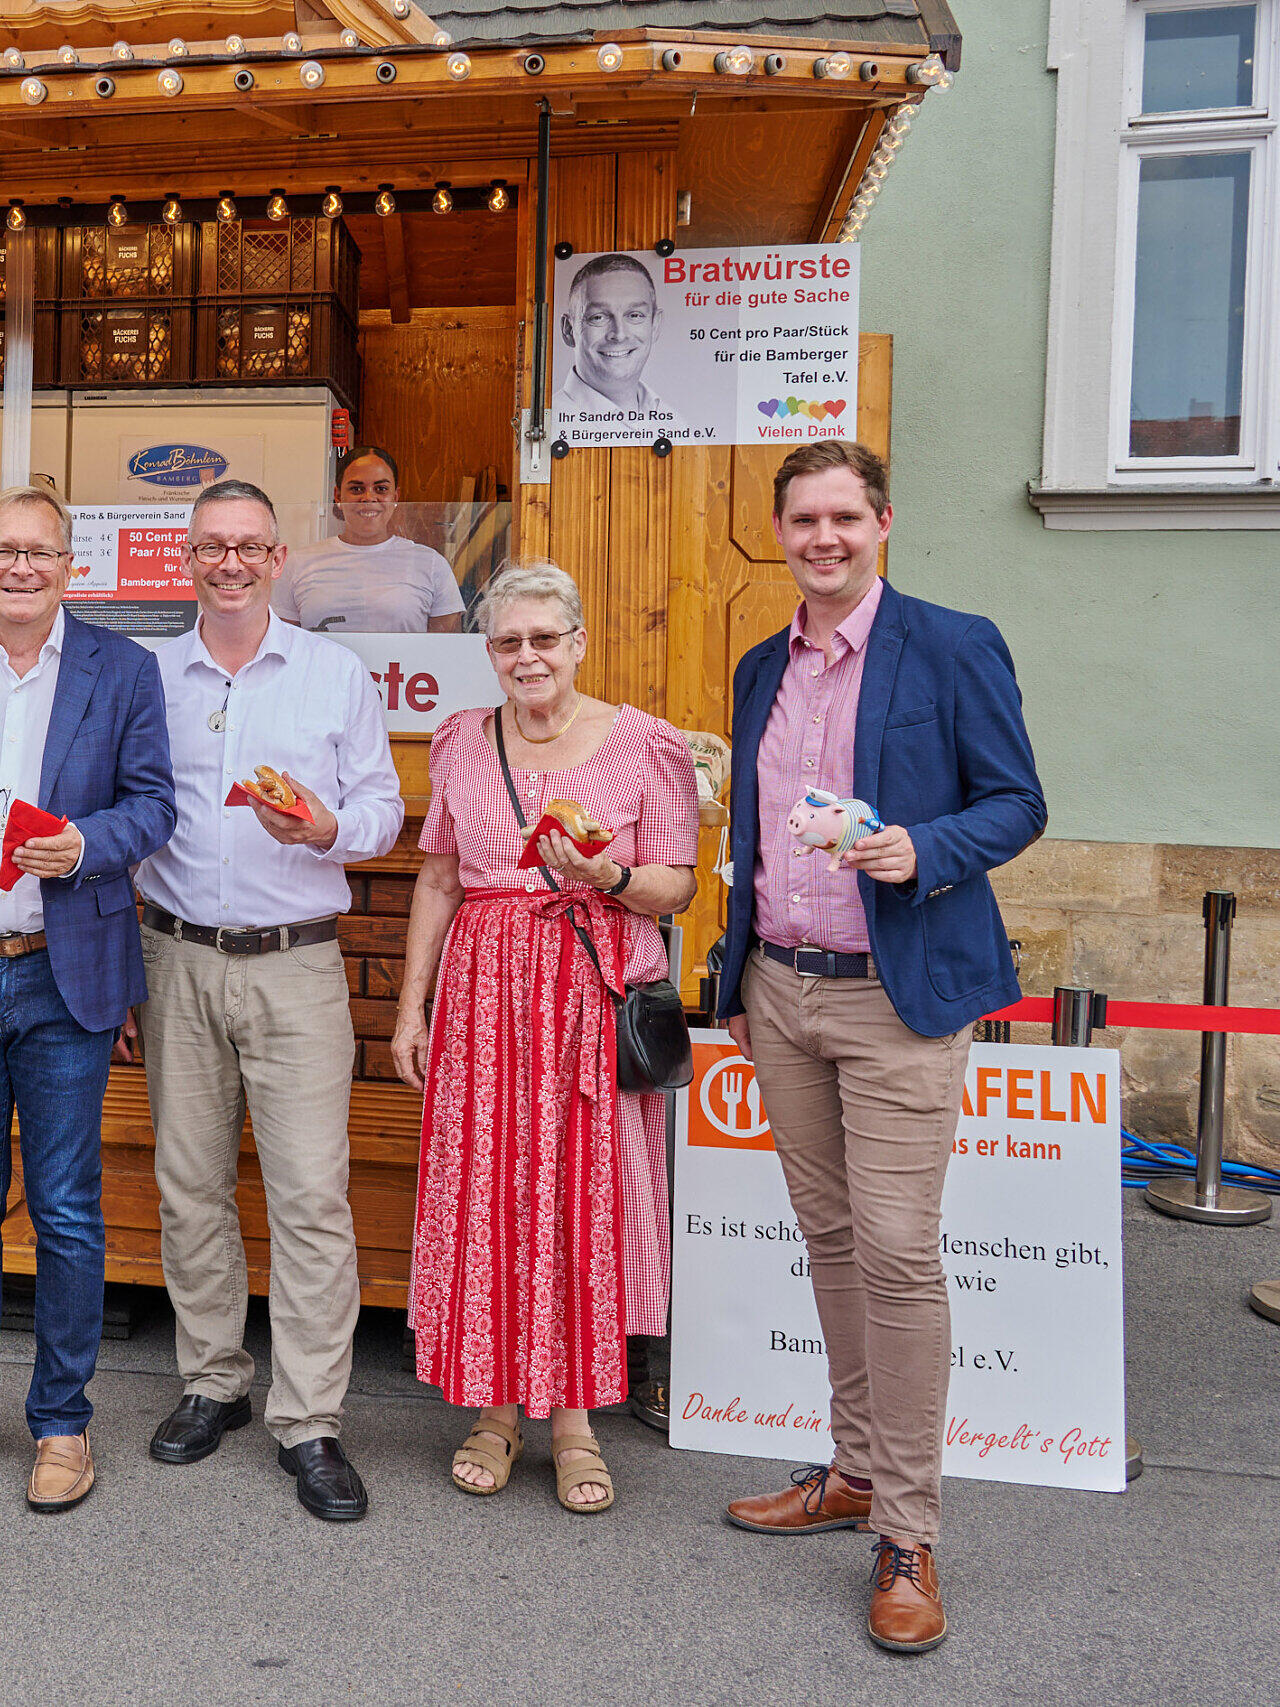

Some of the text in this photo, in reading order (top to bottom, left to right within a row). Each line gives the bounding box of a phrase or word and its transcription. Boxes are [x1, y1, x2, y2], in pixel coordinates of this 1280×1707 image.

[664, 253, 851, 283] Bratwürste
[685, 288, 850, 308] für die gute Sache
[114, 335, 137, 343] FUCHS
[689, 325, 849, 341] 50 Cent pro Paar/Stück
[714, 348, 849, 363] für die Bamberger
[782, 371, 849, 384] Tafel e.V.
[558, 412, 576, 423] Ihr
[628, 410, 645, 421] Da
[648, 410, 674, 421] Ros
[558, 426, 717, 442] & Bürgerverein Sand e.V.
[758, 424, 846, 438] Vielen Dank
[133, 450, 173, 473] Konrad
[107, 512, 161, 521] Bürgerverein
[164, 512, 186, 520] Sand
[100, 533, 106, 542] 4
[129, 532, 188, 544] 50 Cent pr
[100, 549, 105, 557] 3
[130, 546, 182, 557] Paar / Stü
[164, 563, 177, 572] für
[120, 578, 169, 588] Bamberger
[976, 1139, 999, 1156] er
[1007, 1134, 1061, 1160] kann
[686, 1214, 805, 1242] Es ist schö
[1055, 1242, 1109, 1269] gibt,
[790, 1256, 812, 1277] di
[955, 1270, 997, 1292] wie
[770, 1330, 828, 1354] Bam
[973, 1350, 1018, 1372] e.V.
[682, 1392, 822, 1432] Danke und ein
[1059, 1427, 1111, 1464] Gott
